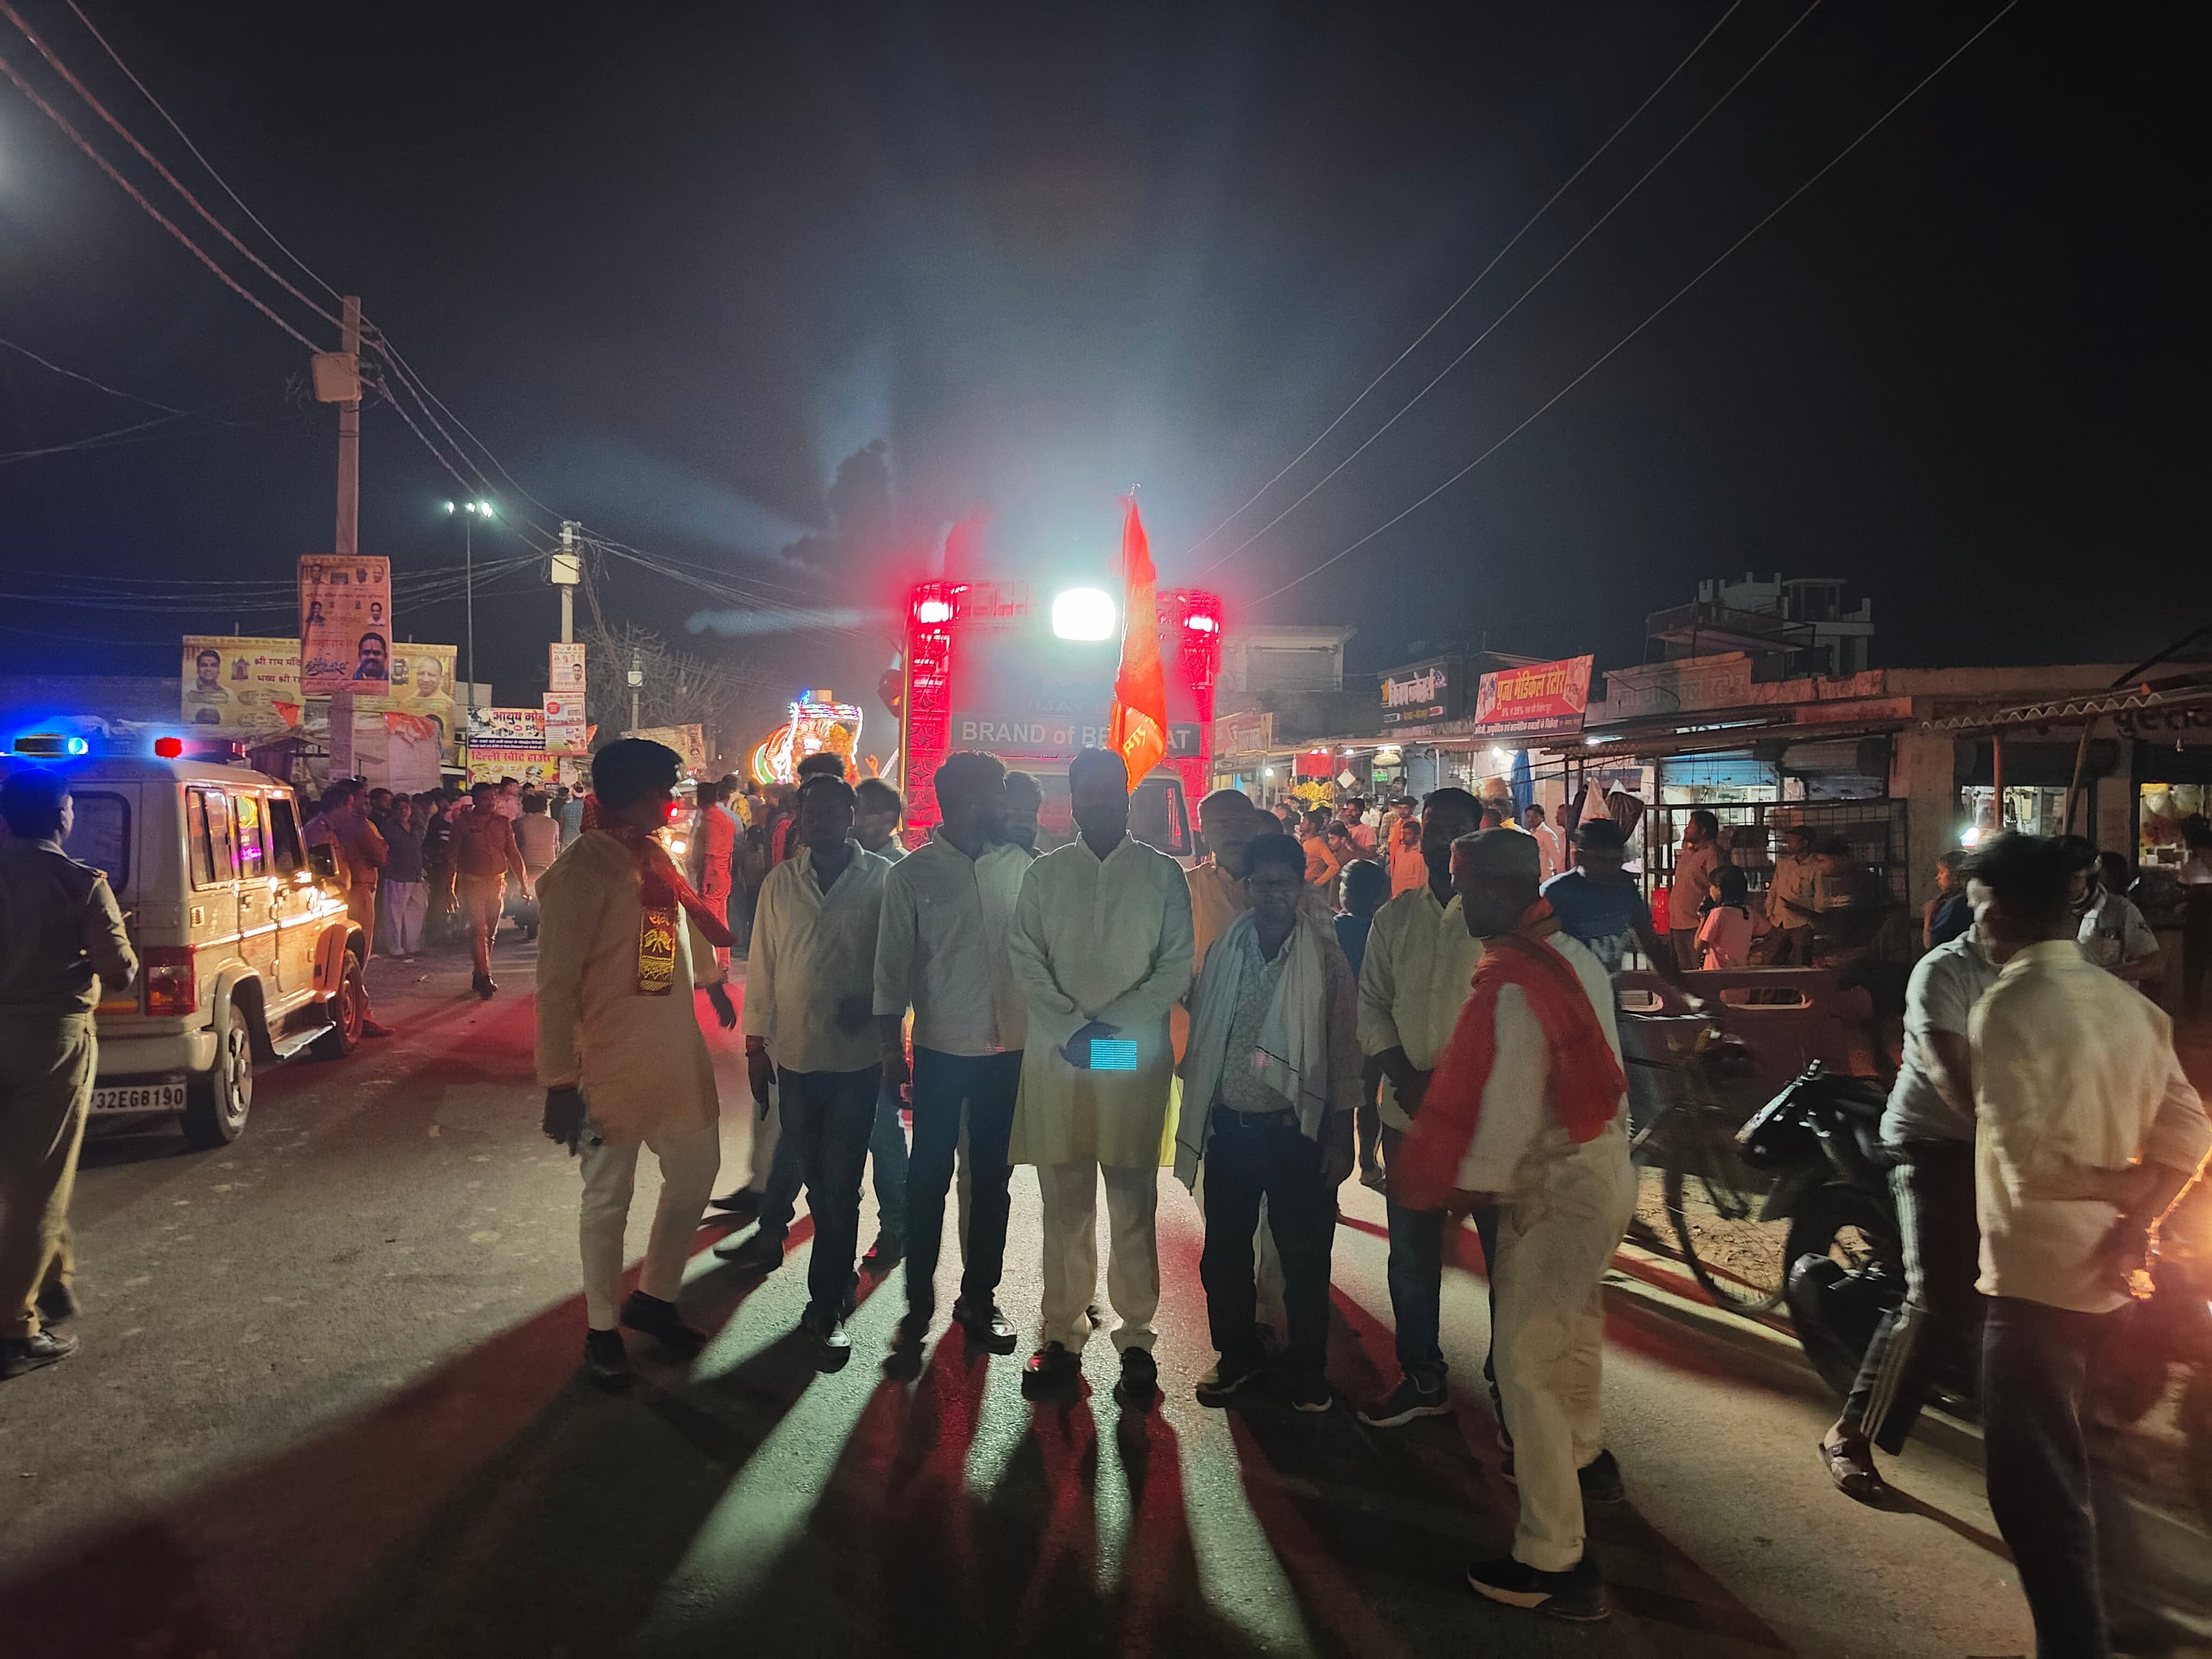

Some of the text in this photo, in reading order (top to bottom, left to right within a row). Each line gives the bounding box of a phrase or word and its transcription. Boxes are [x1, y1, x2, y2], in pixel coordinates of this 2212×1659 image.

[286, 657, 302, 666] मंदि
[1497, 664, 1567, 710] पूजा मेडिकल स्टोर
[963, 721, 1046, 743] BRAND
[1053, 726, 1075, 745] of
[471, 751, 501, 762] दिल्ली
[503, 751, 525, 762] स्वीट
